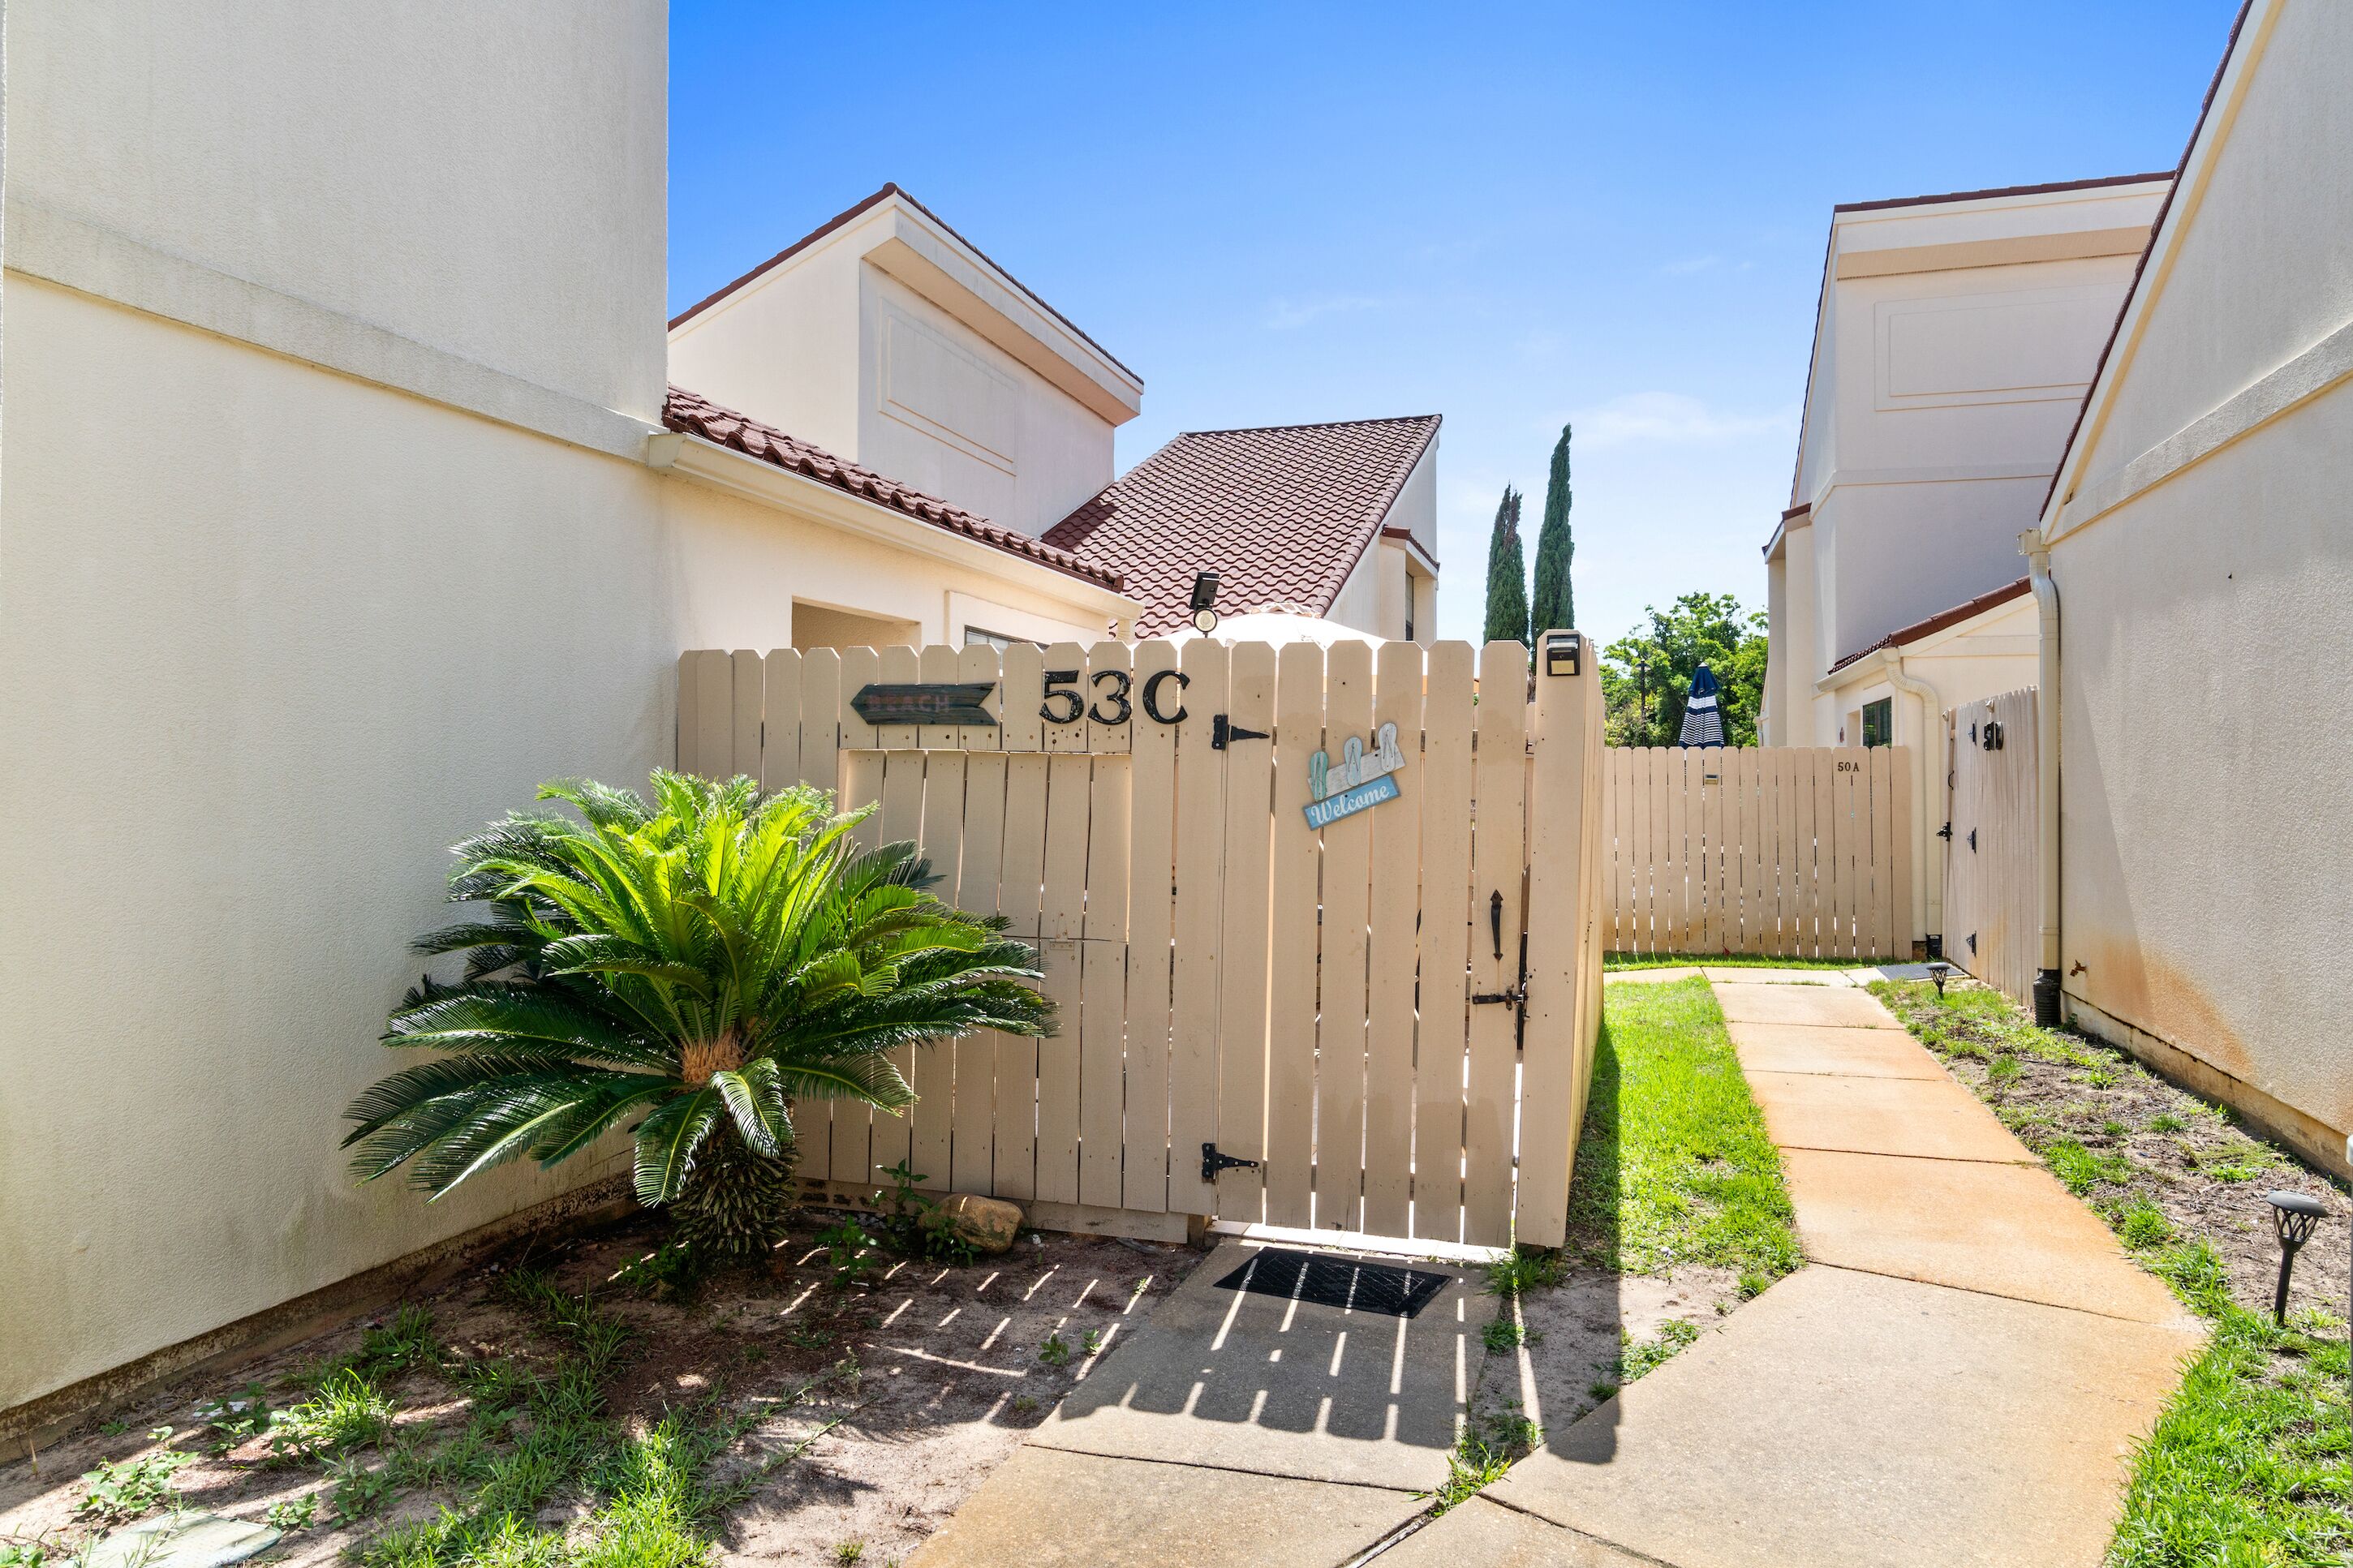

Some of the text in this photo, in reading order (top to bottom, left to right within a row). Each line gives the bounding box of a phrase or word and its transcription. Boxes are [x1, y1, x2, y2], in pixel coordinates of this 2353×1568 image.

[866, 694, 949, 712] BEACH
[1039, 670, 1190, 724] 53C
[1838, 762, 1860, 772] 50A
[1310, 785, 1390, 824] Welcome
